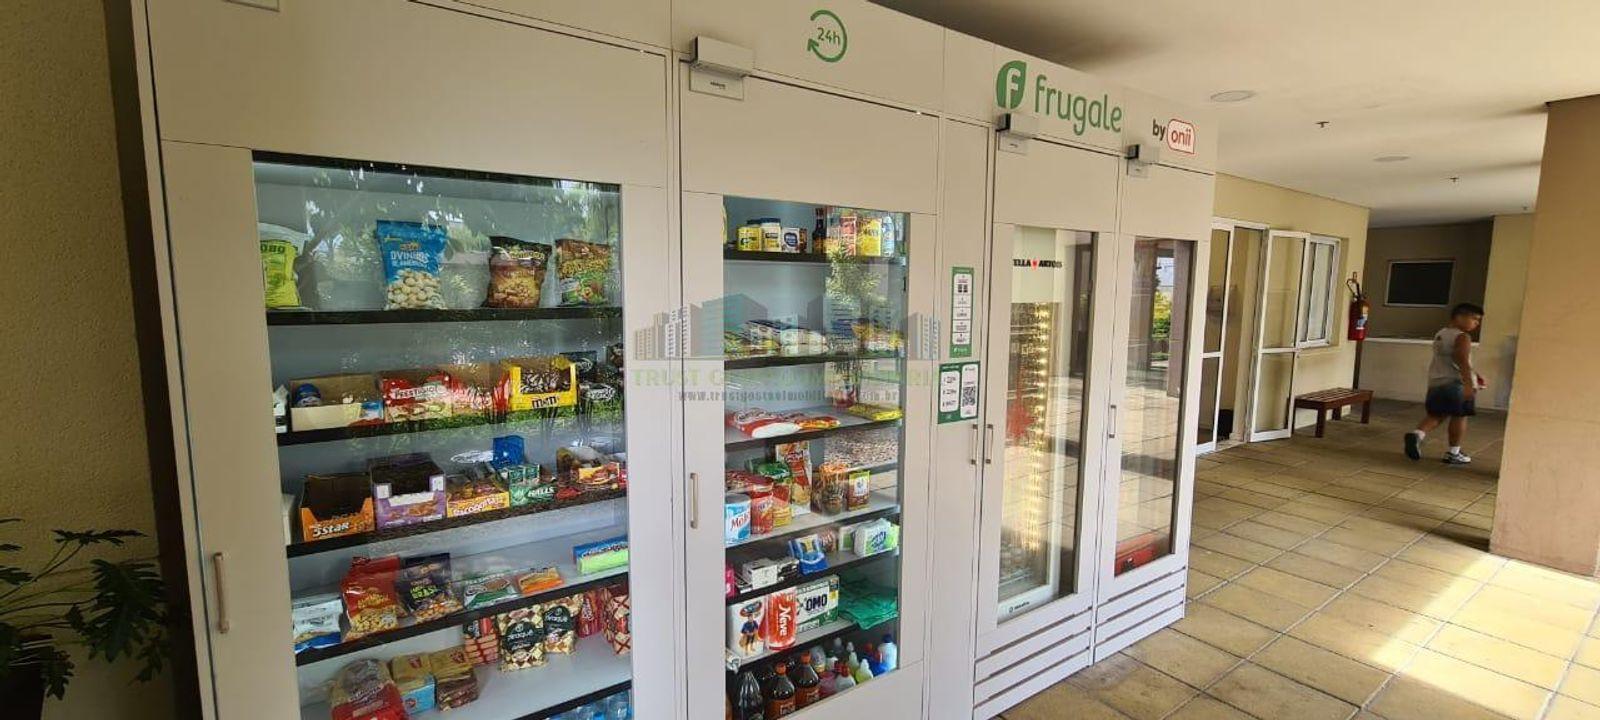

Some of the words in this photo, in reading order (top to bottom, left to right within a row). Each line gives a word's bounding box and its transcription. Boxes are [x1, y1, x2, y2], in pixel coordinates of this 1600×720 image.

[817, 27, 840, 46] 24h
[1034, 74, 1122, 136] frugale
[1152, 118, 1166, 141] by
[1171, 128, 1191, 147] onii
[527, 486, 555, 498] HALLS
[806, 594, 828, 611] OMO
[779, 603, 791, 637] Neve
